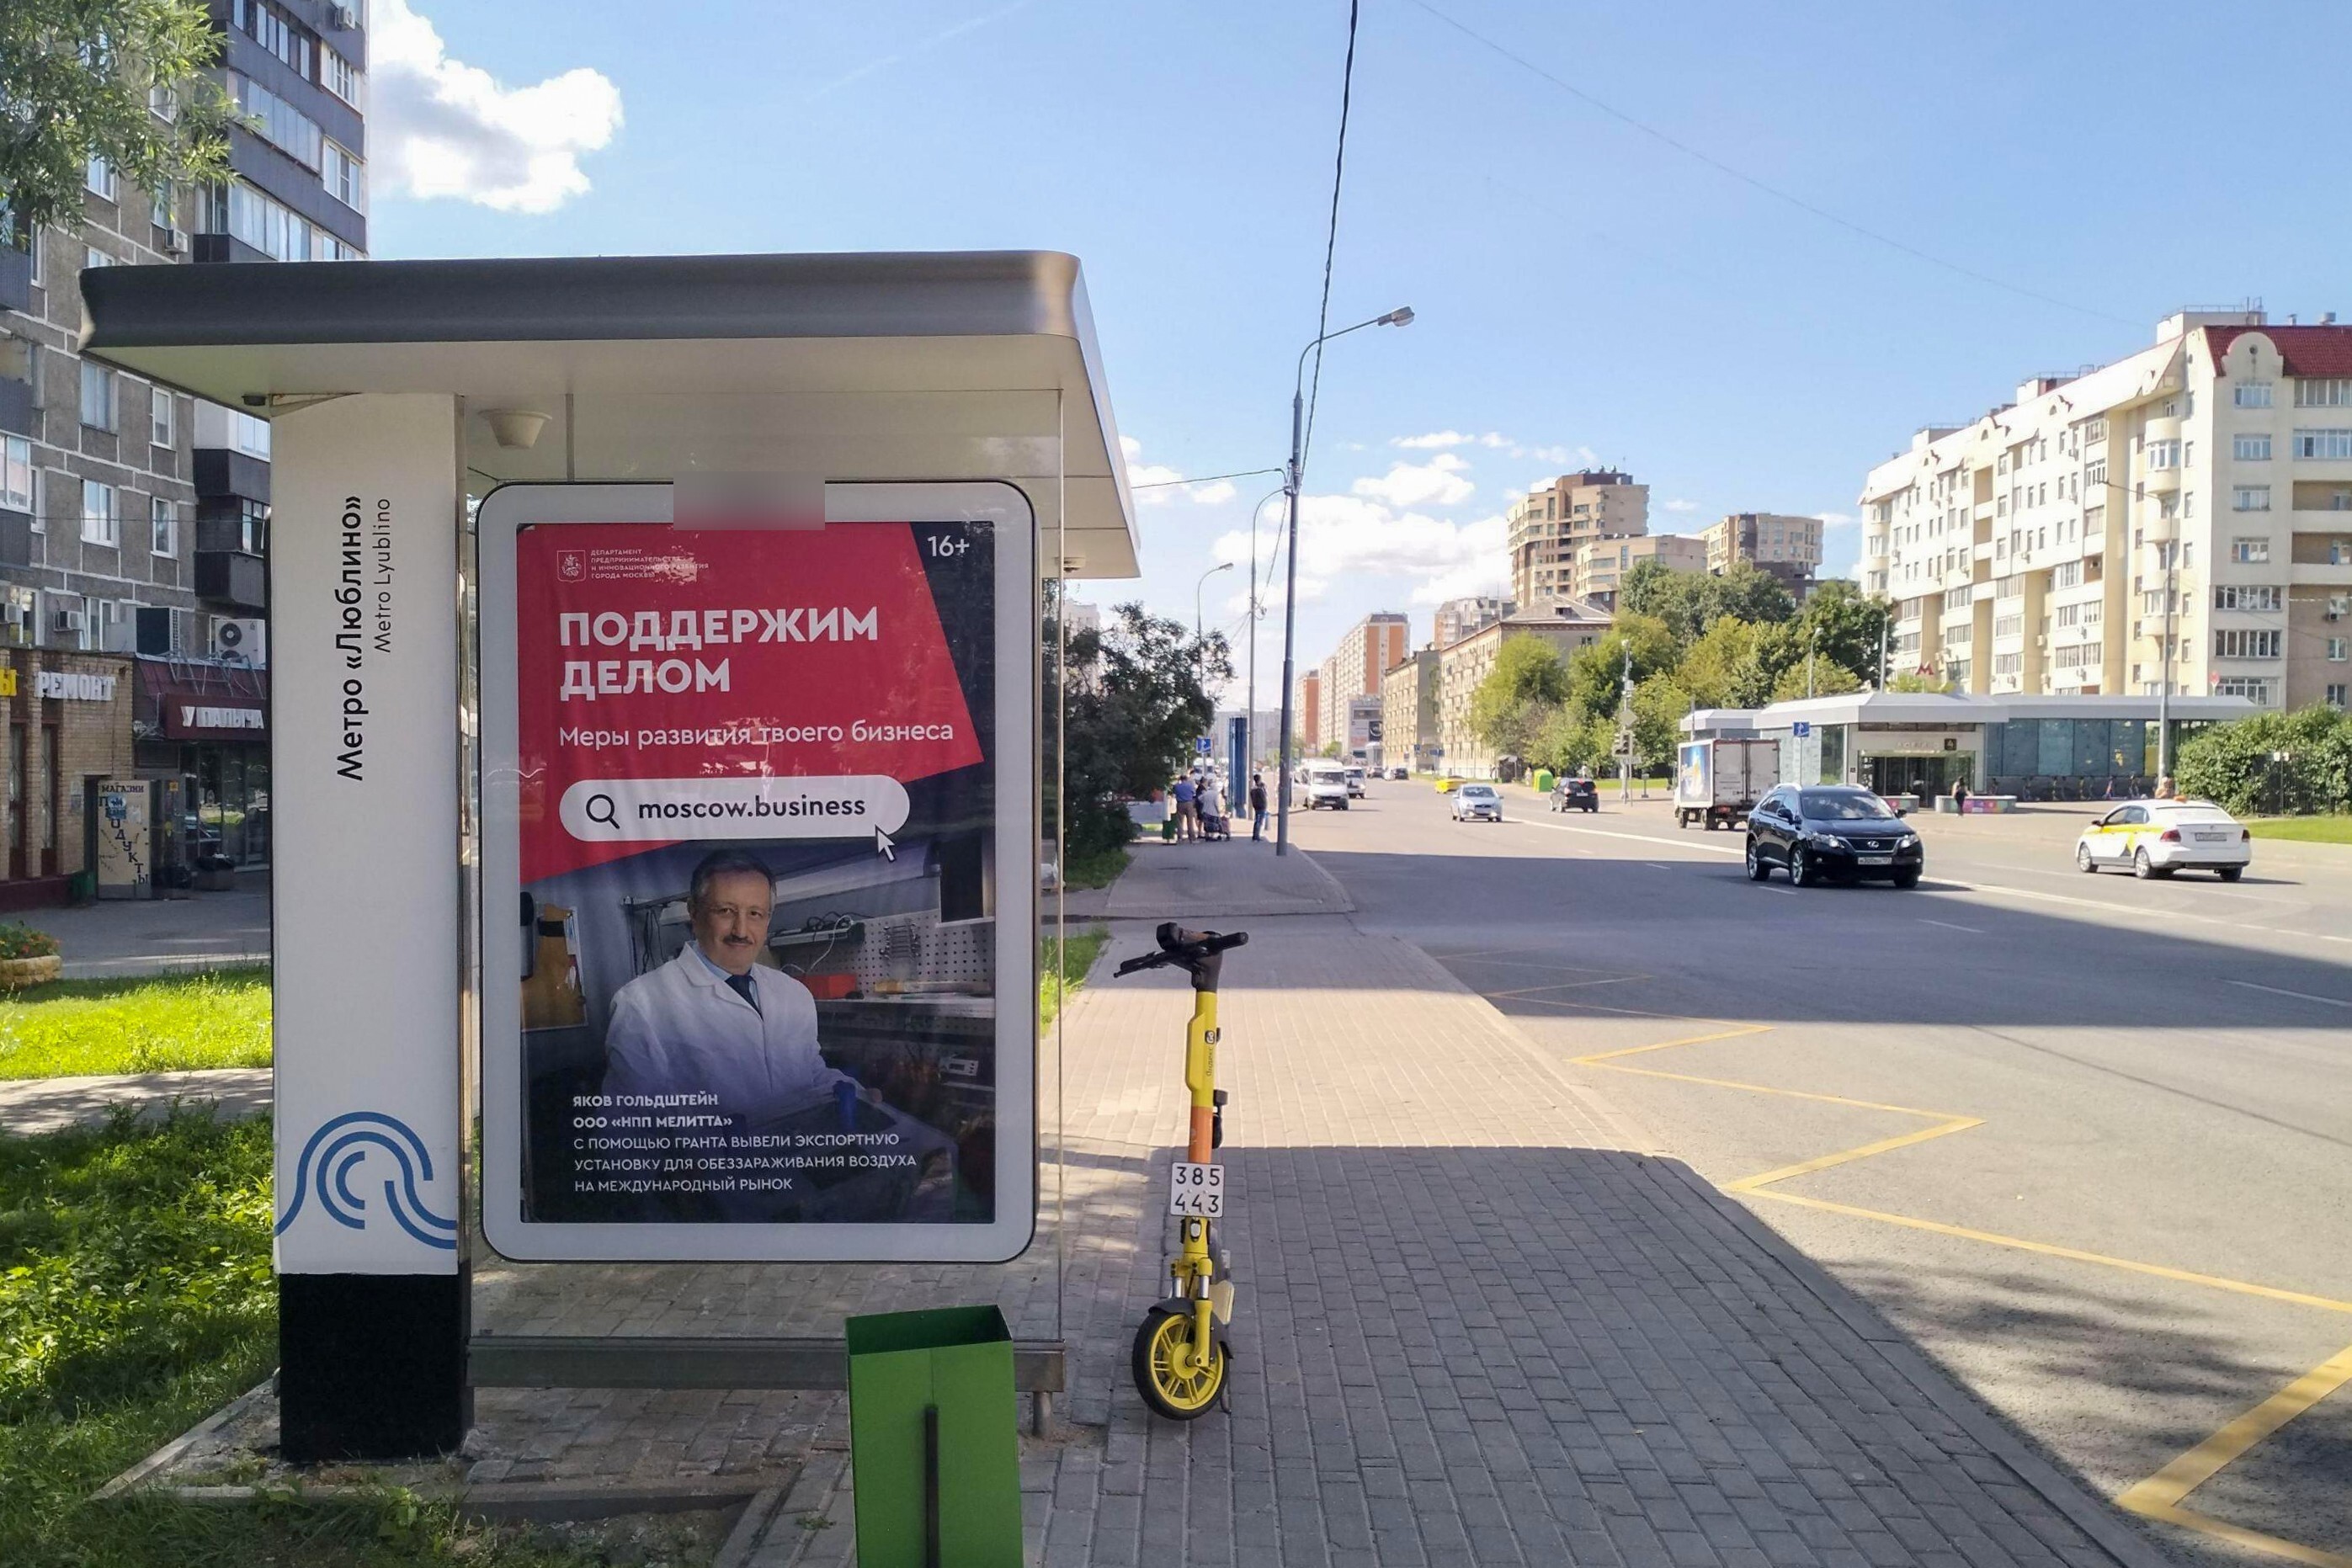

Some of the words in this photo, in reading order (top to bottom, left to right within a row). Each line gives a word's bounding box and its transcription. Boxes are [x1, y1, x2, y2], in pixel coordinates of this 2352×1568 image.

[372, 498, 395, 584] Lyublino
[927, 534, 970, 556] 16+
[334, 496, 363, 669] «Люблино»
[374, 591, 391, 653] Metro
[560, 606, 878, 651] ПОДДЕРЖИМ
[37, 672, 116, 700] РЕМОНТ
[560, 658, 730, 702] ДЕЛОМ
[180, 706, 195, 727] У
[337, 678, 369, 781] Метро
[560, 726, 630, 750] Меры
[638, 727, 750, 750] развития
[758, 726, 843, 743] твоего
[851, 720, 953, 742] бизнеса
[101, 784, 144, 793] МАГАЗИН
[639, 794, 865, 819] moscow.business
[98, 795, 148, 885] ПОДУКТЫ
[573, 1095, 613, 1107] ЯКОВ
[616, 1091, 718, 1108] ГОЛЬДШТЕЙН
[573, 1117, 608, 1128] ООО
[612, 1116, 652, 1128] «НПП
[656, 1115, 732, 1128] МЕЛИТТА»
[573, 1138, 584, 1150] С
[588, 1138, 671, 1151] ПОМОЩЬЮ
[675, 1137, 727, 1149] ГРАНТА
[731, 1135, 790, 1148] ВЫВЕЛИ
[796, 1134, 899, 1147] ЭКСПОРТНУЮ
[574, 1159, 661, 1171] УСТАНОВКУ
[664, 1158, 693, 1172] ДЛЯ
[697, 1156, 844, 1170] ОБЕЗЗАРАЖИВАНИЯ
[849, 1155, 917, 1168] ВОЗДУХА
[575, 1181, 594, 1192] НА
[599, 1176, 736, 1193] МЕЖДУНАРОДНЫЙ
[740, 1178, 793, 1191] РЫНОК
[1175, 1166, 1220, 1187] 385
[1174, 1193, 1219, 1214] 443
